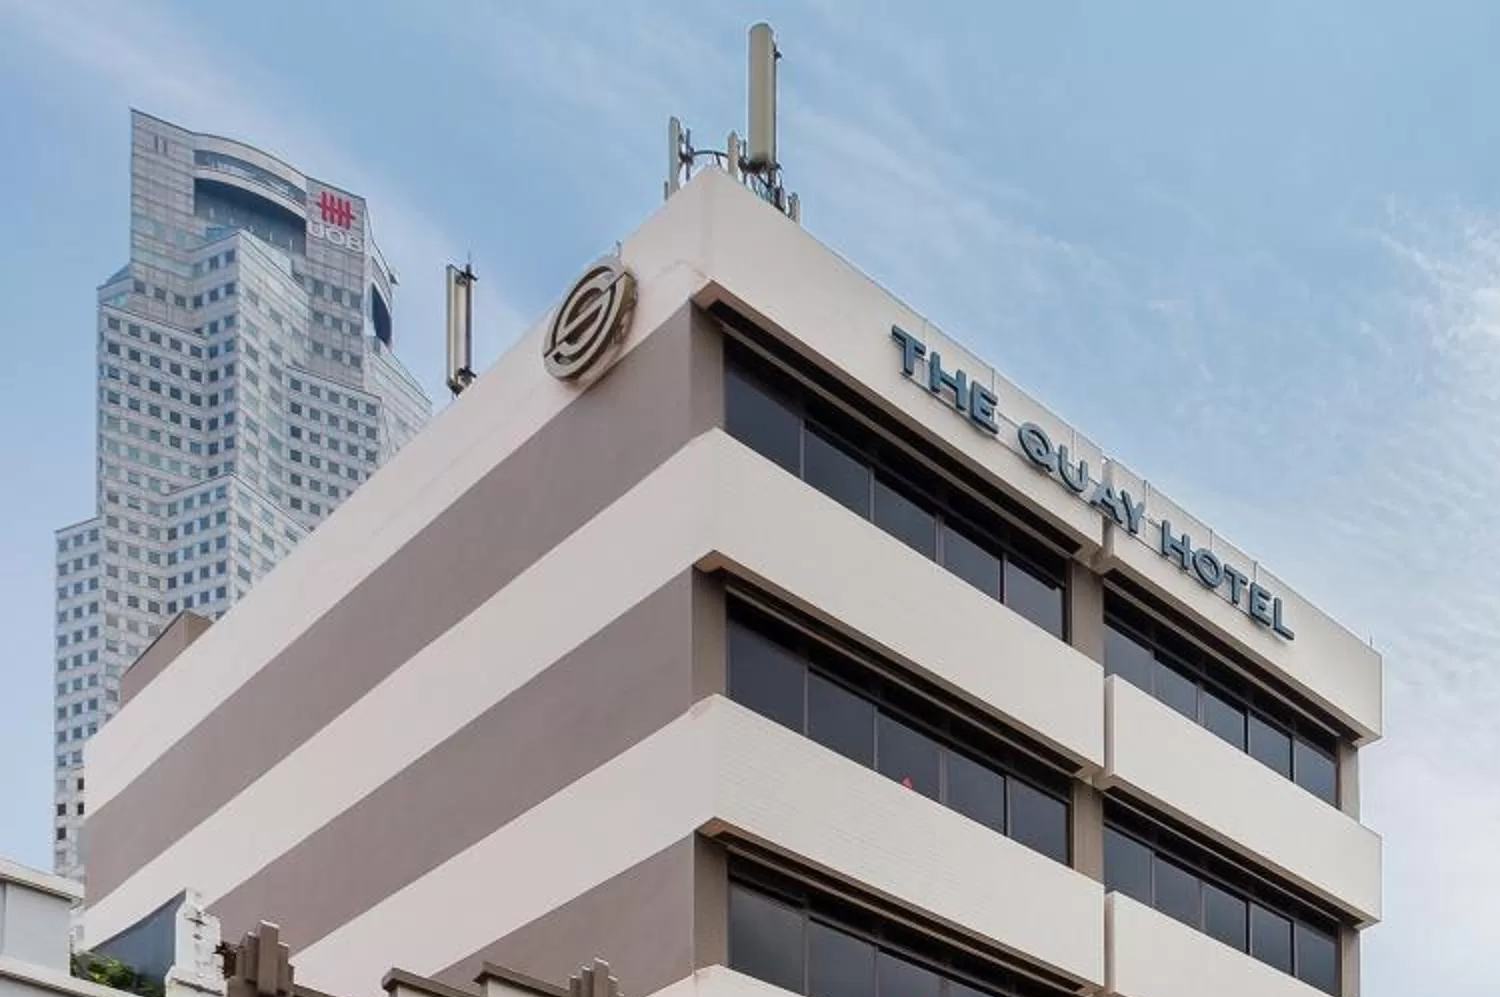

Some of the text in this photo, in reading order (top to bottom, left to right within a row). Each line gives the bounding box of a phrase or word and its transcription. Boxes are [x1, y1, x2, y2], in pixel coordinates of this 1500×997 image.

[307, 220, 363, 252] UOB
[891, 324, 1295, 641] THE QUAY HOTEL
